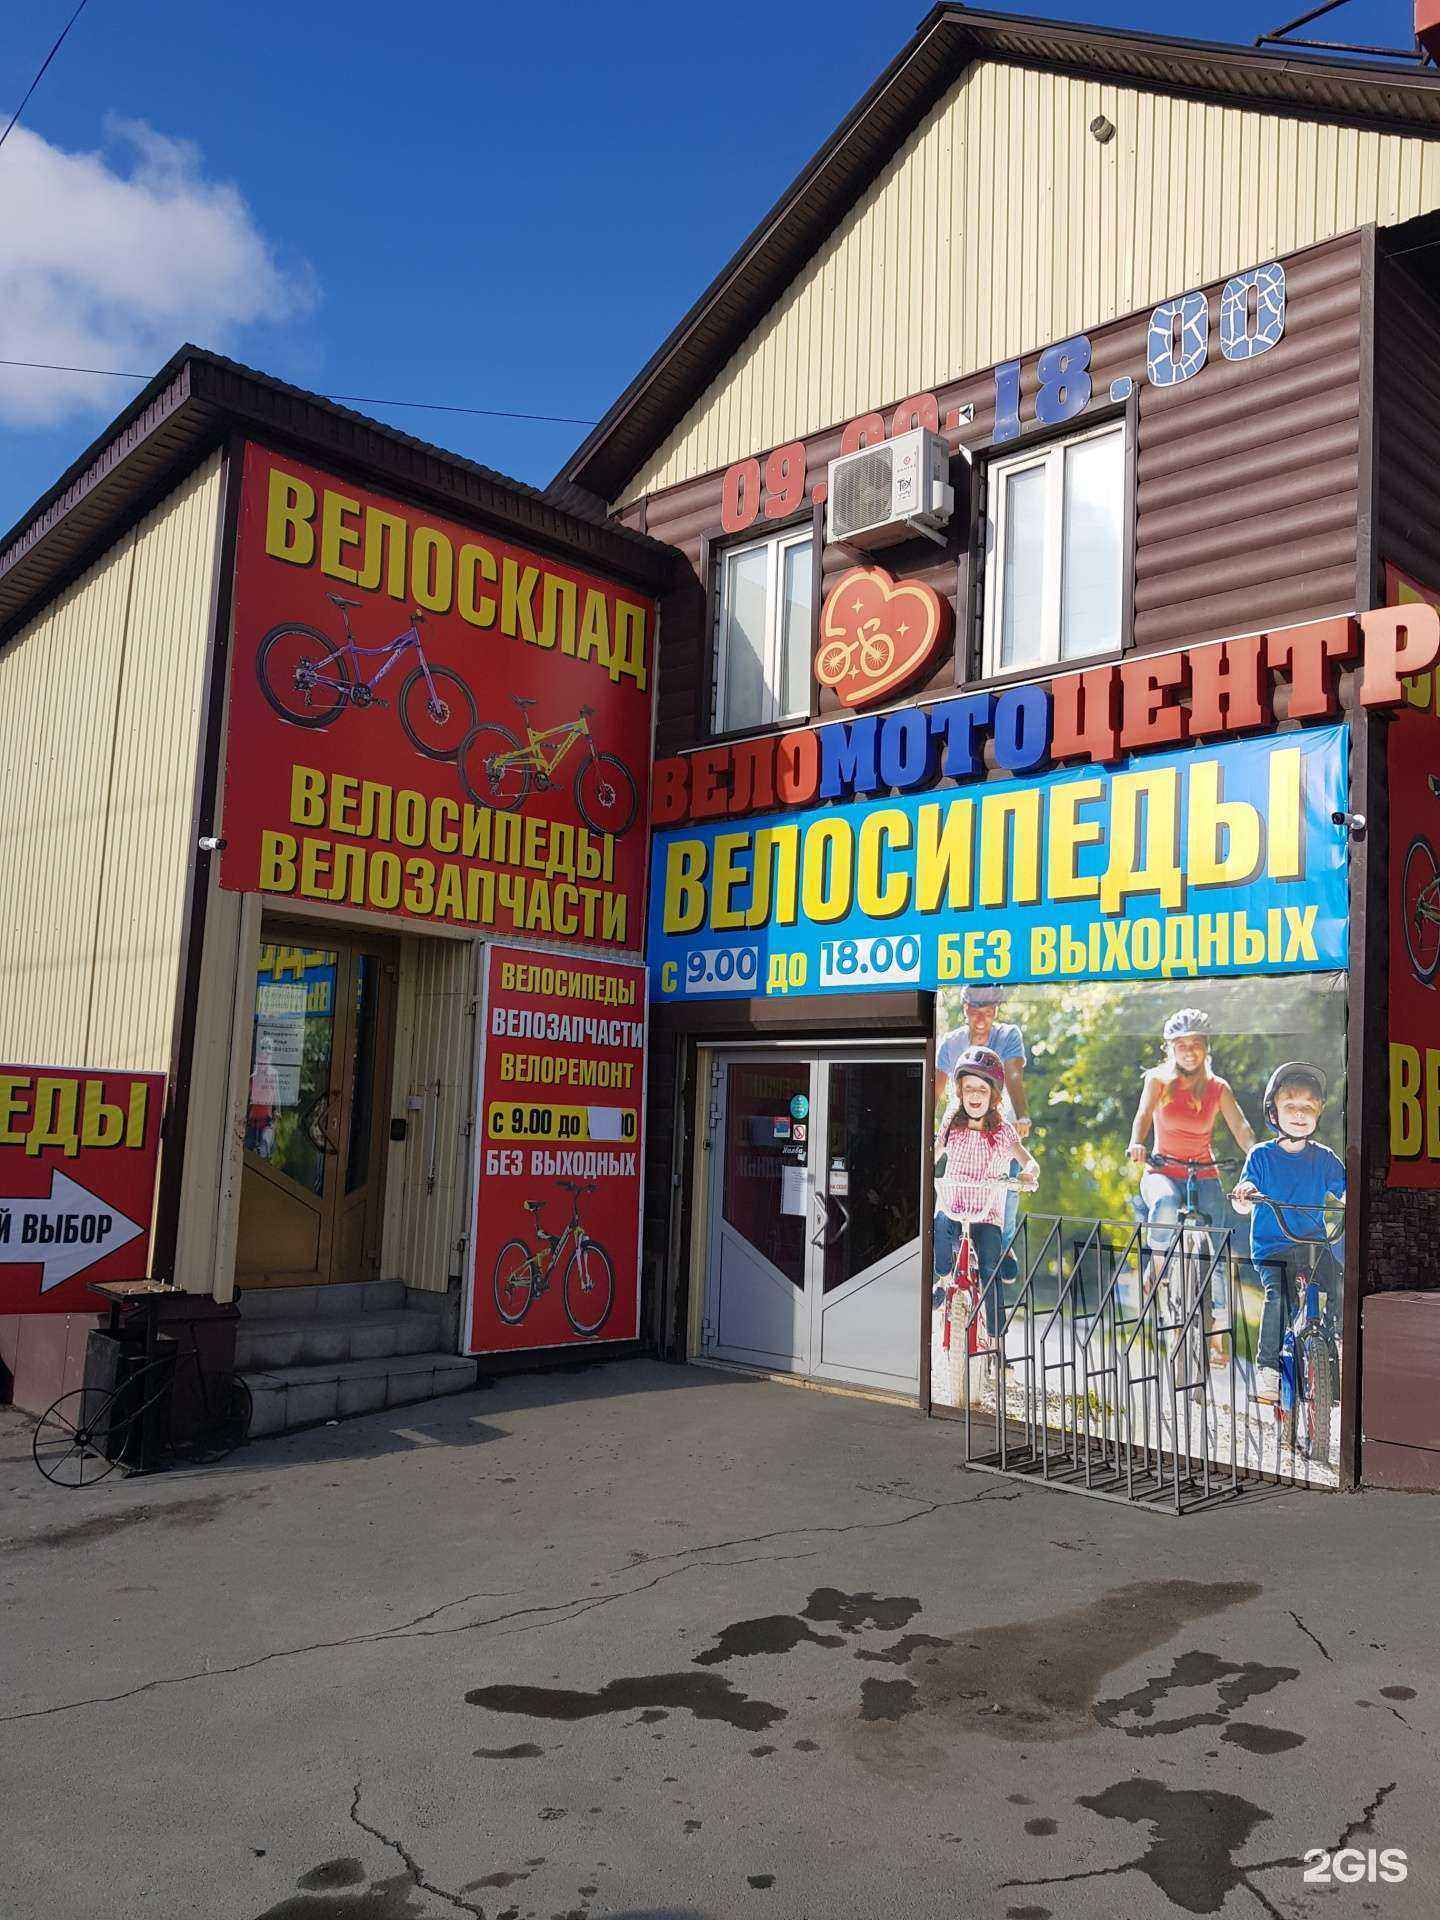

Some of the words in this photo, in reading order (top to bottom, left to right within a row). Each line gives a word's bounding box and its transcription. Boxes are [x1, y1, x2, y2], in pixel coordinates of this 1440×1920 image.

[265, 467, 647, 690] ВЕЛОСКЛАД
[652, 603, 1440, 826] ВЕЛОМОТОЦЕНТР
[289, 764, 614, 883] ВЕЛОСИПЕДЫ
[663, 747, 1301, 935] ВЕЛОСИПЕДЫ
[259, 829, 627, 943] ВЕЛОЗАПЧАСТИ
[687, 949, 757, 982] 9.00
[820, 936, 919, 975] 18.00
[938, 930, 1011, 980] БЕЗ
[1031, 905, 1319, 977] ВЫХОДНЫХ
[501, 962, 636, 1007] ВЕЛОСИПЕДЫ
[492, 1007, 643, 1048] ВЕЛОЗАПЧАСТИ
[500, 1052, 634, 1089] ВЕЛОРЕМОНТ
[512, 1108, 552, 1134] 9.00
[486, 1150, 523, 1176] БЕЗ
[531, 1150, 636, 1179] ВЫХОДНЫХ
[21, 1214, 112, 1244] ВЫБОР
